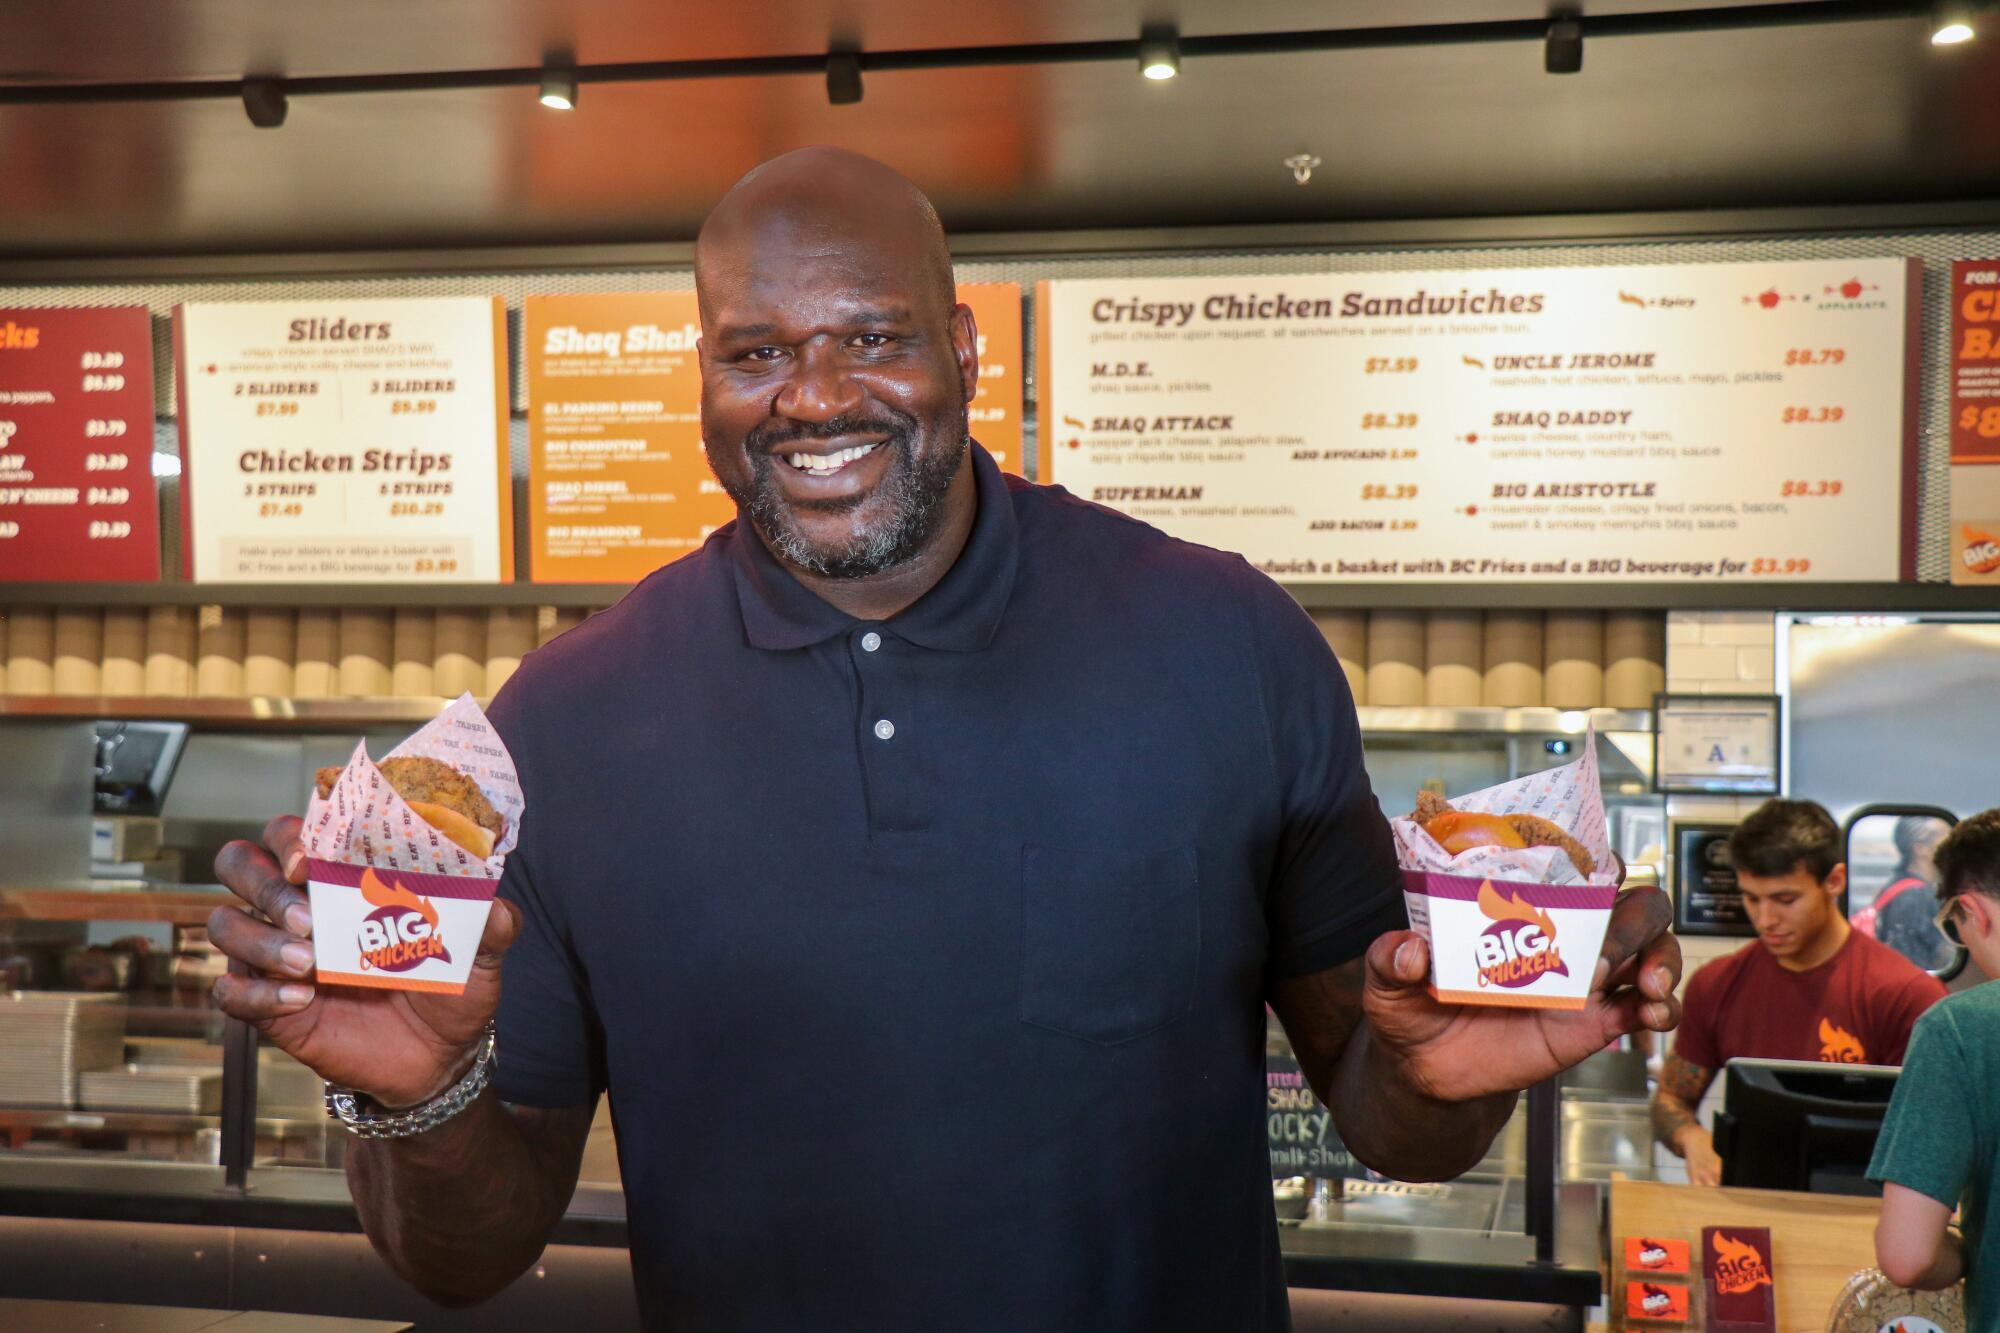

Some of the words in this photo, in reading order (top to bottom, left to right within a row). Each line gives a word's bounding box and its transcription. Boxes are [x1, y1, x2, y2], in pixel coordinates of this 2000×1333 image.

[1964, 272, 1998, 284] FOR
[1092, 297, 1195, 327] Crispy
[1204, 293, 1332, 320] Chicken
[1341, 289, 1544, 317] Sandwiches
[288, 319, 392, 342] Sliders
[544, 327, 620, 357] Shaq
[1493, 355, 1562, 370] UNCLE
[1568, 354, 1656, 369] JEROME
[1785, 349, 1845, 366] $8.79
[1091, 363, 1154, 378] M.D.E.
[1734, 372, 1784, 384] pickles
[235, 383, 244, 395] 2
[249, 382, 319, 395] SLIDERS
[370, 380, 381, 394] 3
[385, 379, 456, 393] SLIDERS
[1361, 413, 1419, 430] $8.39
[1492, 412, 1551, 429] SHAQ
[1557, 410, 1632, 426] DADDY
[1782, 406, 1845, 424] $8.39
[1092, 417, 1147, 434] SHAQ
[1153, 416, 1234, 431] ATTACK
[239, 449, 354, 473] Chicken
[362, 449, 453, 476] Strips
[1292, 451, 1319, 460] ADD
[1323, 450, 1386, 460] AVOCADO
[245, 484, 253, 496] 3
[257, 483, 316, 495] STRIPS
[393, 482, 453, 495] STRIPS
[1092, 485, 1203, 501] SUPERMAN
[1361, 484, 1419, 500] $8.39
[1492, 484, 1527, 498] BIG
[1533, 483, 1656, 498] ARISTOTLE
[1780, 480, 1844, 497] $8.39
[1309, 521, 1336, 531] ADD
[1340, 520, 1384, 531] BACON
[1963, 542, 2000, 567] BIG
[1321, 561, 1332, 573] a
[1337, 558, 1399, 574] basket
[1403, 558, 1445, 574] with
[1450, 559, 1476, 573] BC
[1479, 559, 1527, 573] Fries
[1531, 559, 1567, 573] and
[1571, 561, 1582, 573] a
[1587, 559, 1622, 573] BIG
[1626, 559, 1714, 576] beverage
[1717, 557, 1747, 576] for
[1751, 557, 1811, 575] $3.99
[1707, 744, 1726, 762] A
[359, 912, 431, 950] BIG
[359, 933, 444, 971] CHICKEN
[1476, 924, 1548, 968] BIG
[1476, 949, 1561, 988] CHICKEN
[1267, 1087, 1314, 1110] SHAQ
[1716, 1255, 1756, 1279] BIG
[1718, 1266, 1767, 1294] CHICKEN
[1642, 1293, 1670, 1311] BIG
